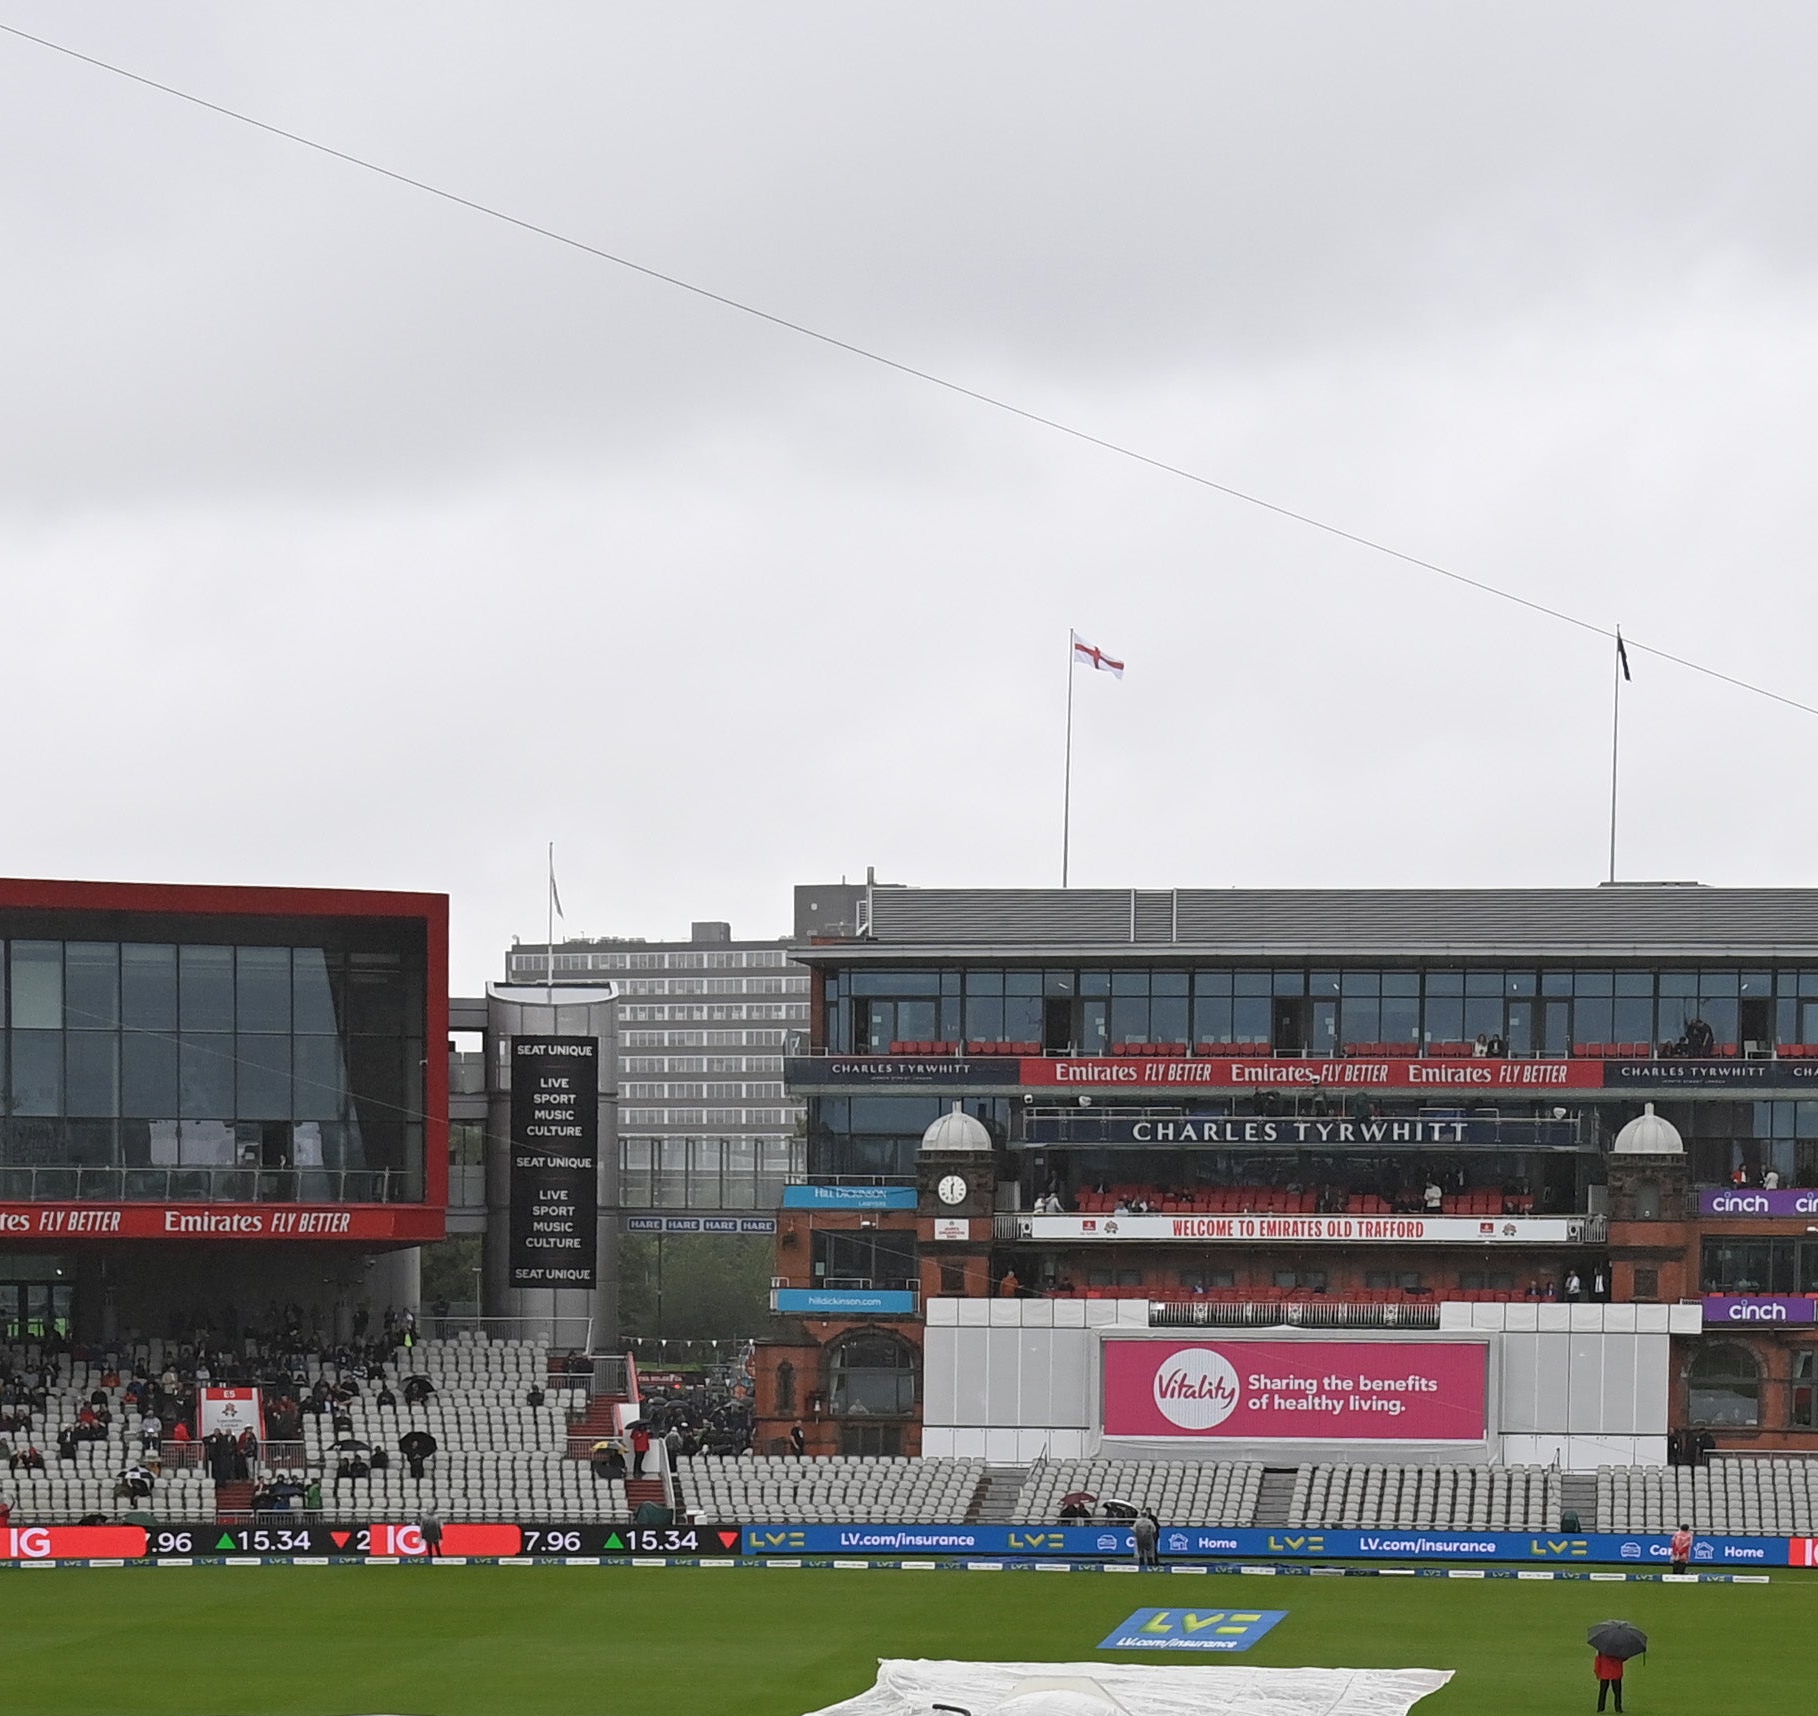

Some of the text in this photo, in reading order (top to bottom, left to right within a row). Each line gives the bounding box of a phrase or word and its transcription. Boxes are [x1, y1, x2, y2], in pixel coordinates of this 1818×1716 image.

[517, 1045, 593, 1057] SEAT UNIQUE
[831, 1064, 971, 1074] CHARLES TYRWHITT
[1055, 1063, 1211, 1082] Emirates FLY BETTER
[1231, 1064, 1388, 1082] Emirates FLY BETTER
[1409, 1064, 1567, 1084] Emirates FLY BETTER
[1621, 1067, 1766, 1077] CHARLES TYRWHITT
[540, 1078, 569, 1088] LIVE
[533, 1094, 576, 1104] SPORT
[535, 1110, 575, 1120] MUSIC
[527, 1126, 582, 1136] CULTURE
[1132, 1122, 1468, 1142] CHARLES TYRWHITT
[516, 1158, 592, 1169] SEAT UNIQUE
[539, 1190, 568, 1200] LIVE
[1713, 1192, 1769, 1213] cinch
[533, 1206, 575, 1216] SPORT
[39, 1211, 65, 1232] FLY
[67, 1211, 121, 1232] BETTER
[165, 1210, 351, 1233] Emirates FLY BETTER
[533, 1222, 573, 1232] MUSIC
[631, 1220, 773, 1231] HARE HARE HARE HARE
[1173, 1220, 1425, 1238] WELCOME TO EMIRATES OLD TRAFFORD
[525, 1238, 581, 1248] CULTURE
[515, 1270, 591, 1281] SEAT UNIQUE
[1729, 1300, 1787, 1320] cinch
[1158, 1369, 1236, 1409] Vitality
[1248, 1375, 1438, 1394] Sharing the benefits
[1248, 1394, 1407, 1415] of healthy living.
[10, 1527, 51, 1558] IG
[238, 1530, 311, 1551] 15.34
[387, 1524, 427, 1555] IG
[524, 1530, 699, 1552] 7.96 15.34
[841, 1532, 975, 1550] LV.com/insurance
[1199, 1537, 1237, 1548] Home
[1360, 1537, 1496, 1554] LV.com/insurance
[1725, 1546, 1765, 1558] Home
[1116, 1637, 1237, 1648] LV.com/insurance
